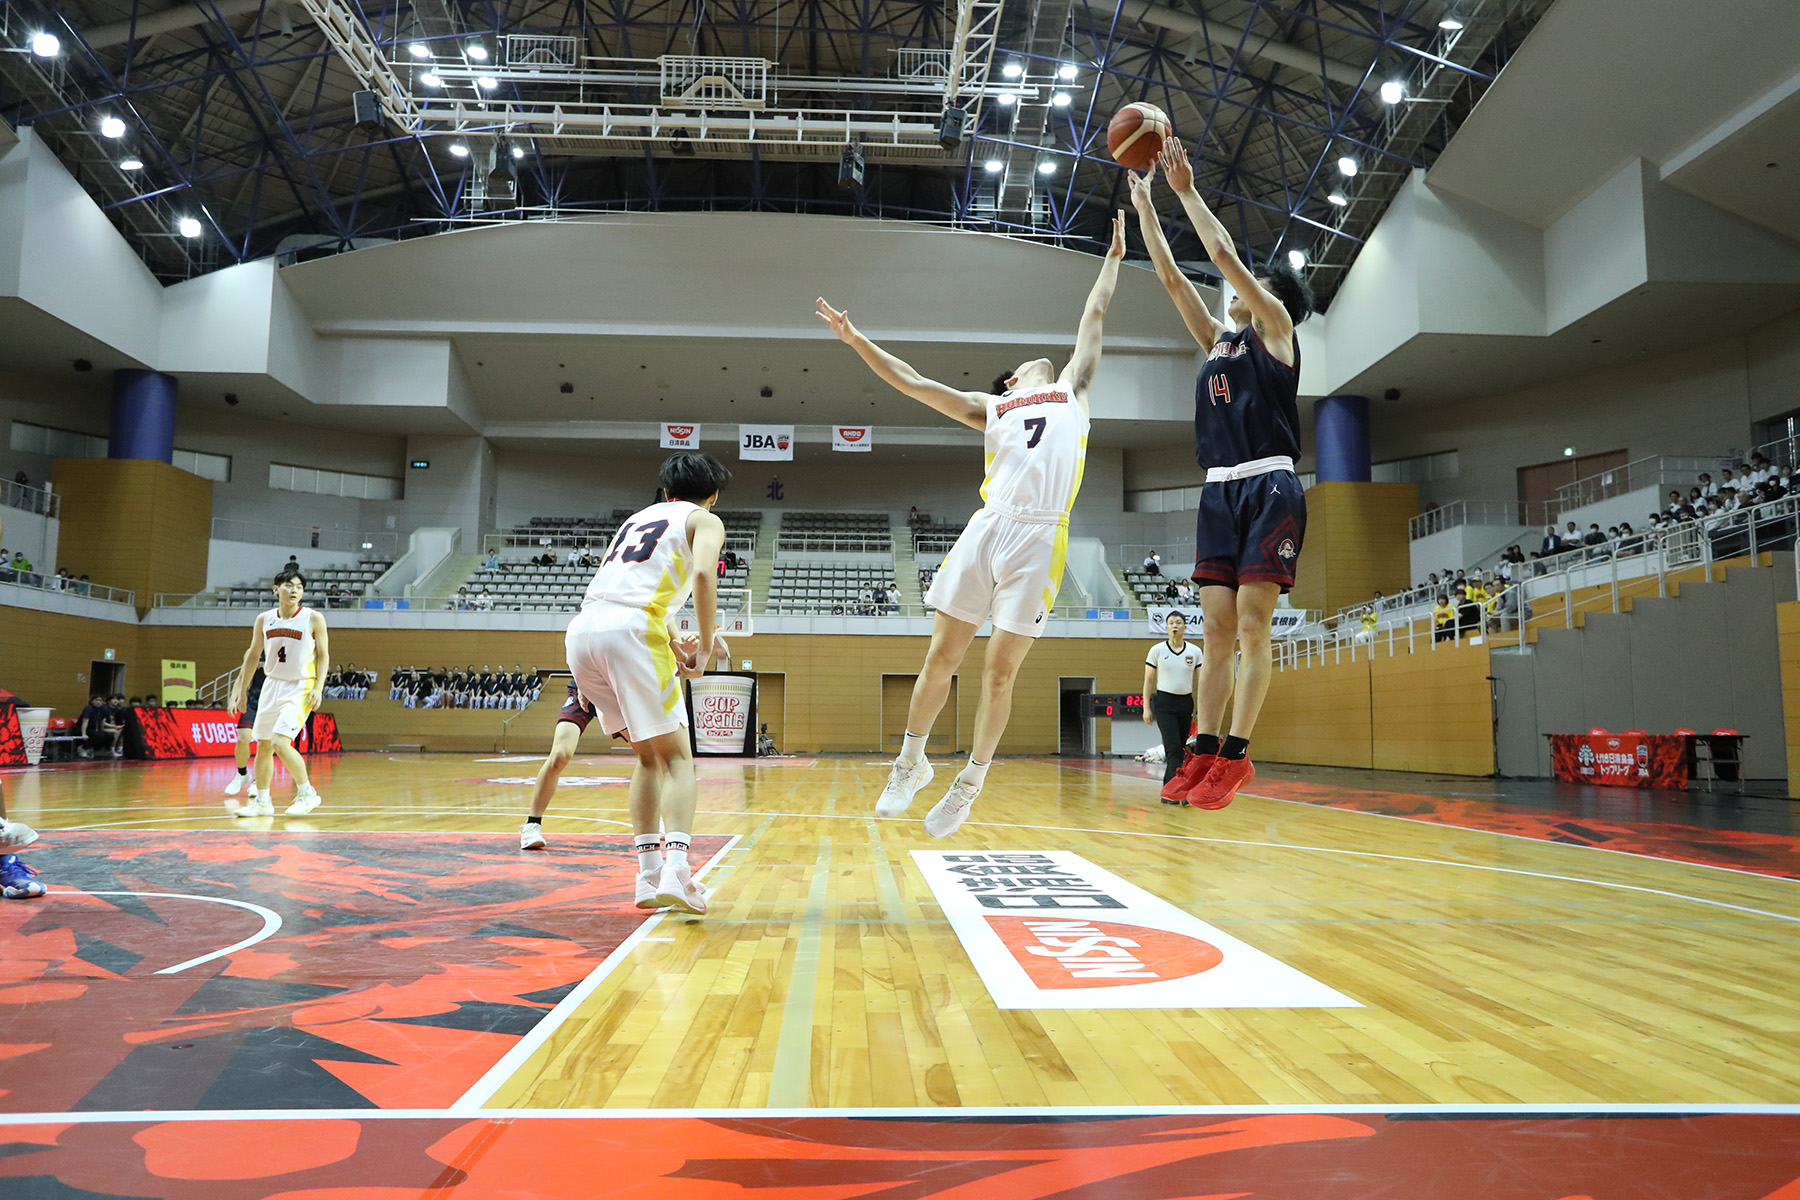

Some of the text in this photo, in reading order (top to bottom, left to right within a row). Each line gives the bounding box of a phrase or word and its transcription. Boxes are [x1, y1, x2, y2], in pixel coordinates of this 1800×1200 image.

[1208, 373, 1231, 406] 14
[996, 391, 1068, 420] HOKURIKU
[669, 426, 691, 435] NISSIN
[1024, 417, 1047, 449] 7
[743, 435, 776, 448] JBA
[767, 481, 784, 501] 北
[603, 519, 669, 566] 13
[278, 646, 286, 662] 4
[703, 696, 740, 713] CUP
[696, 712, 744, 729] NOODLE
[191, 723, 238, 743] #U18日
[1022, 921, 1160, 978] NISSIN
